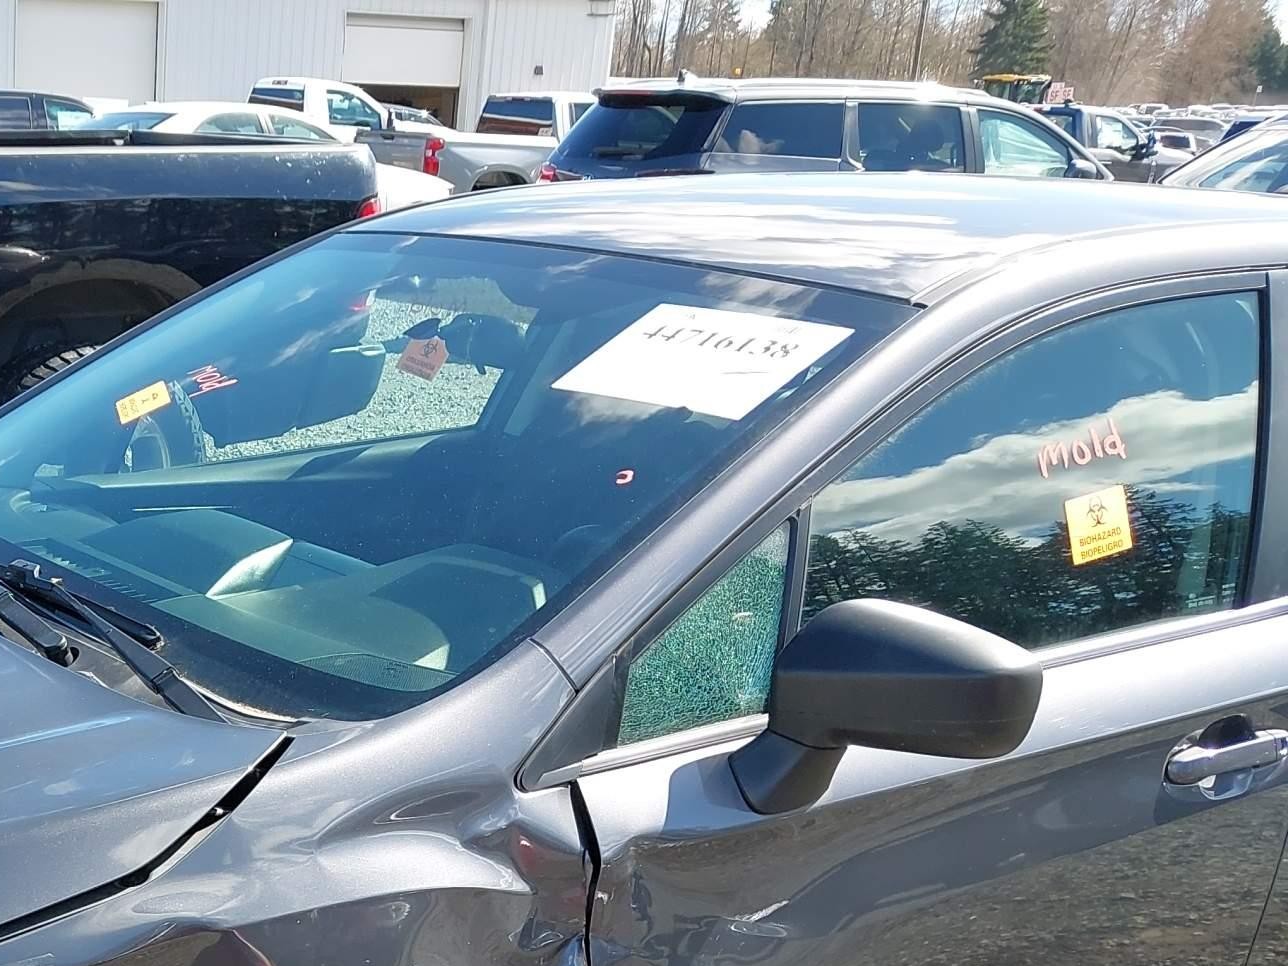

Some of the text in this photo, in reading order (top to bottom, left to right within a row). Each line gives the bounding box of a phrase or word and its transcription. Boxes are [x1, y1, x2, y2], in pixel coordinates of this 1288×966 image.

[642, 325, 800, 359] 44716138
[1079, 526, 1122, 547] BIOHAZARD
[1080, 539, 1124, 560] BIOPELIGRO
